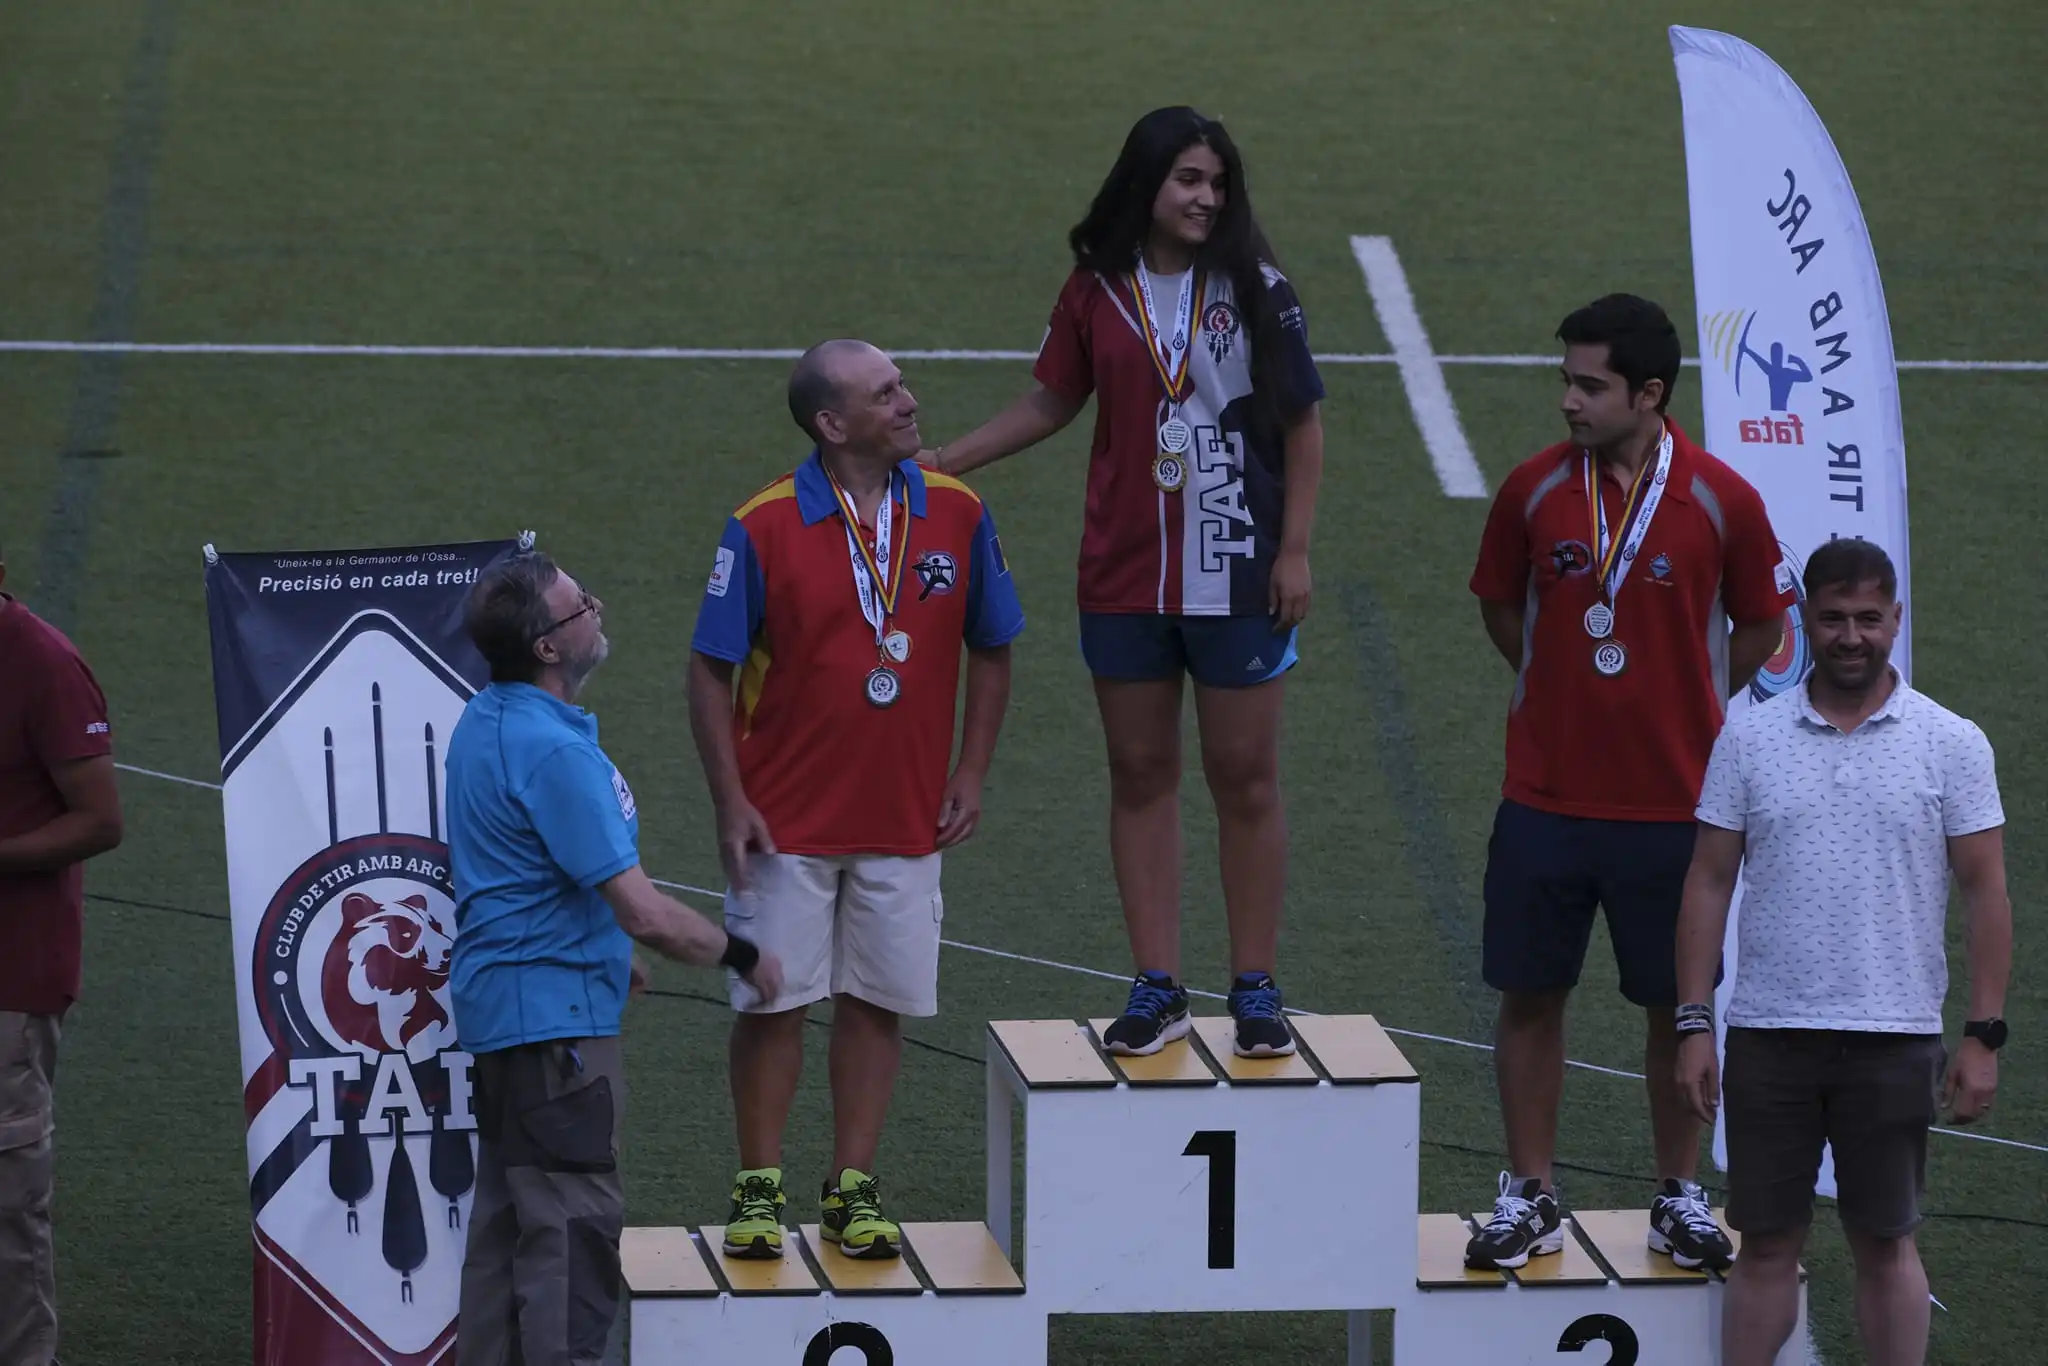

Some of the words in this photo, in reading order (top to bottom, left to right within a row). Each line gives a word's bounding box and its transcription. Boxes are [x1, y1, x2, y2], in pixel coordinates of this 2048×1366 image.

[1195, 425, 1254, 573] TAE
[259, 573, 342, 592] Precisió
[349, 575, 373, 588] en
[381, 571, 429, 587] cada
[436, 567, 479, 585] tret!
[335, 557, 345, 566] la
[349, 555, 402, 566] Germanor
[405, 553, 419, 563] de
[276, 907, 304, 958] CLUB
[298, 883, 324, 911] DE
[320, 863, 355, 889] TIR
[357, 855, 402, 875] AMB
[405, 857, 447, 880] ARC
[1181, 1131, 1236, 1269] 1
